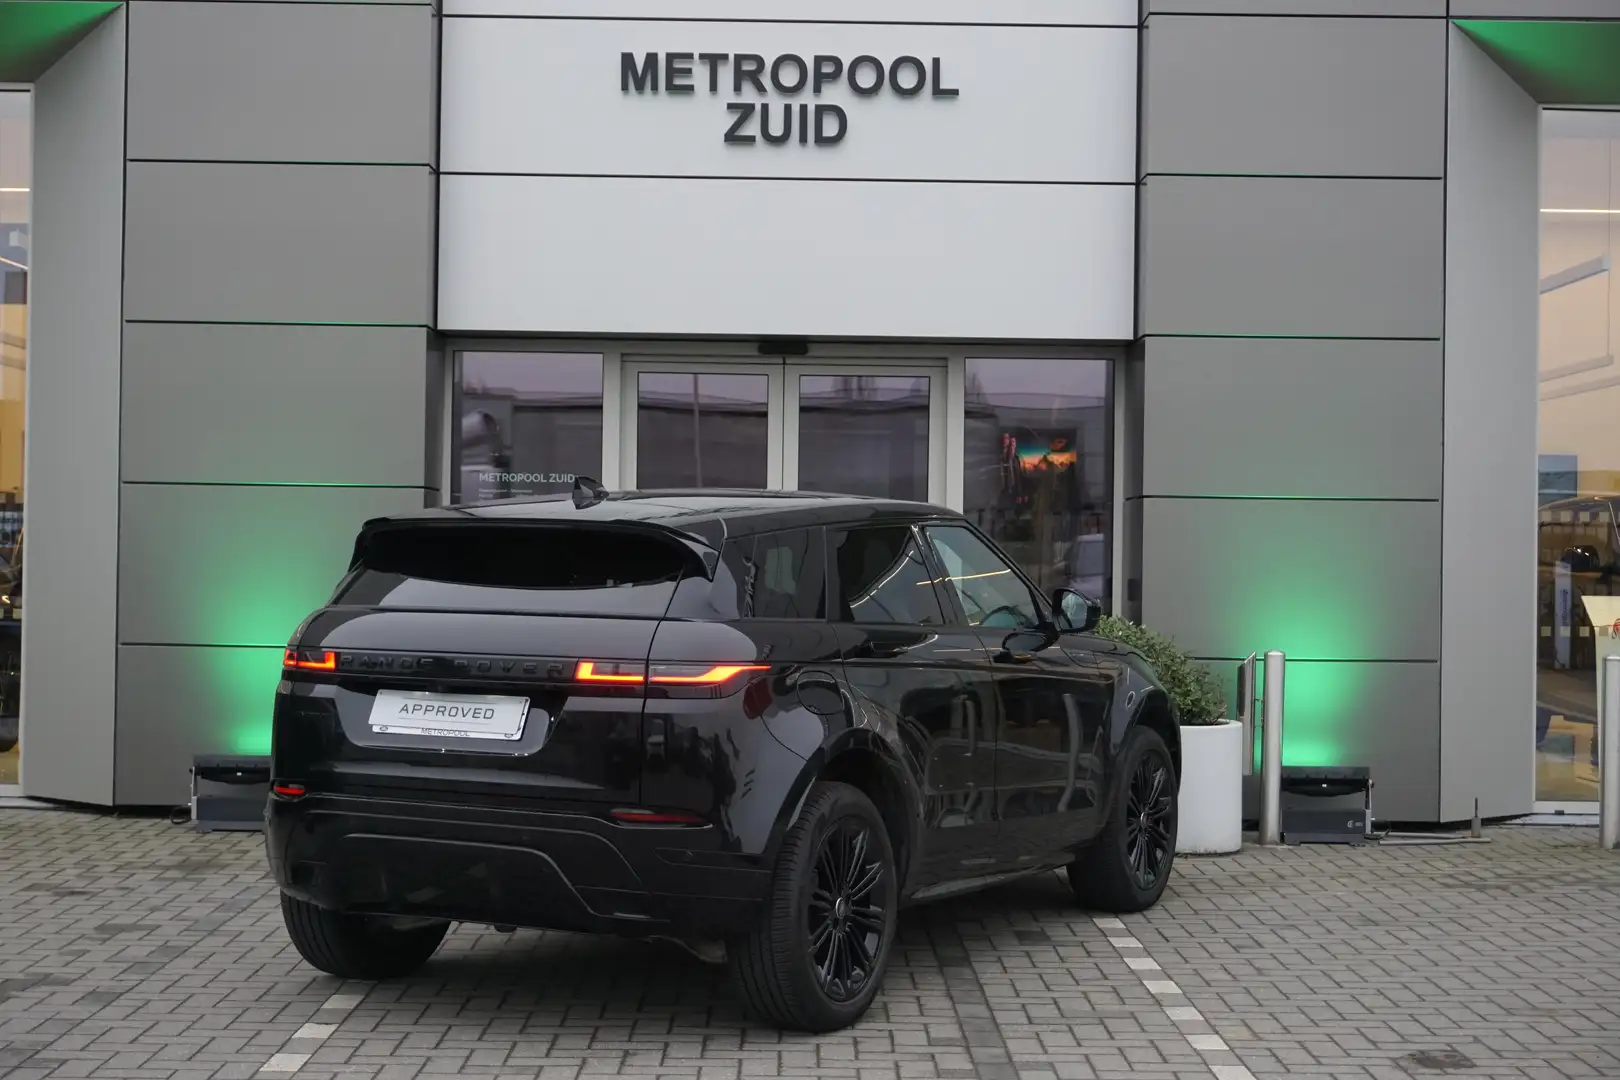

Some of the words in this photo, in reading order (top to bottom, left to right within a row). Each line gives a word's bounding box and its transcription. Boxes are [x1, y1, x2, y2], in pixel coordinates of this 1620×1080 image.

[620, 52, 960, 96] METROPOOL
[723, 102, 848, 144] ZUID
[479, 472, 547, 483] METROPOOL
[548, 473, 575, 483] ZUID
[398, 703, 495, 720] APPROVED
[421, 727, 470, 737] METROPOOL
